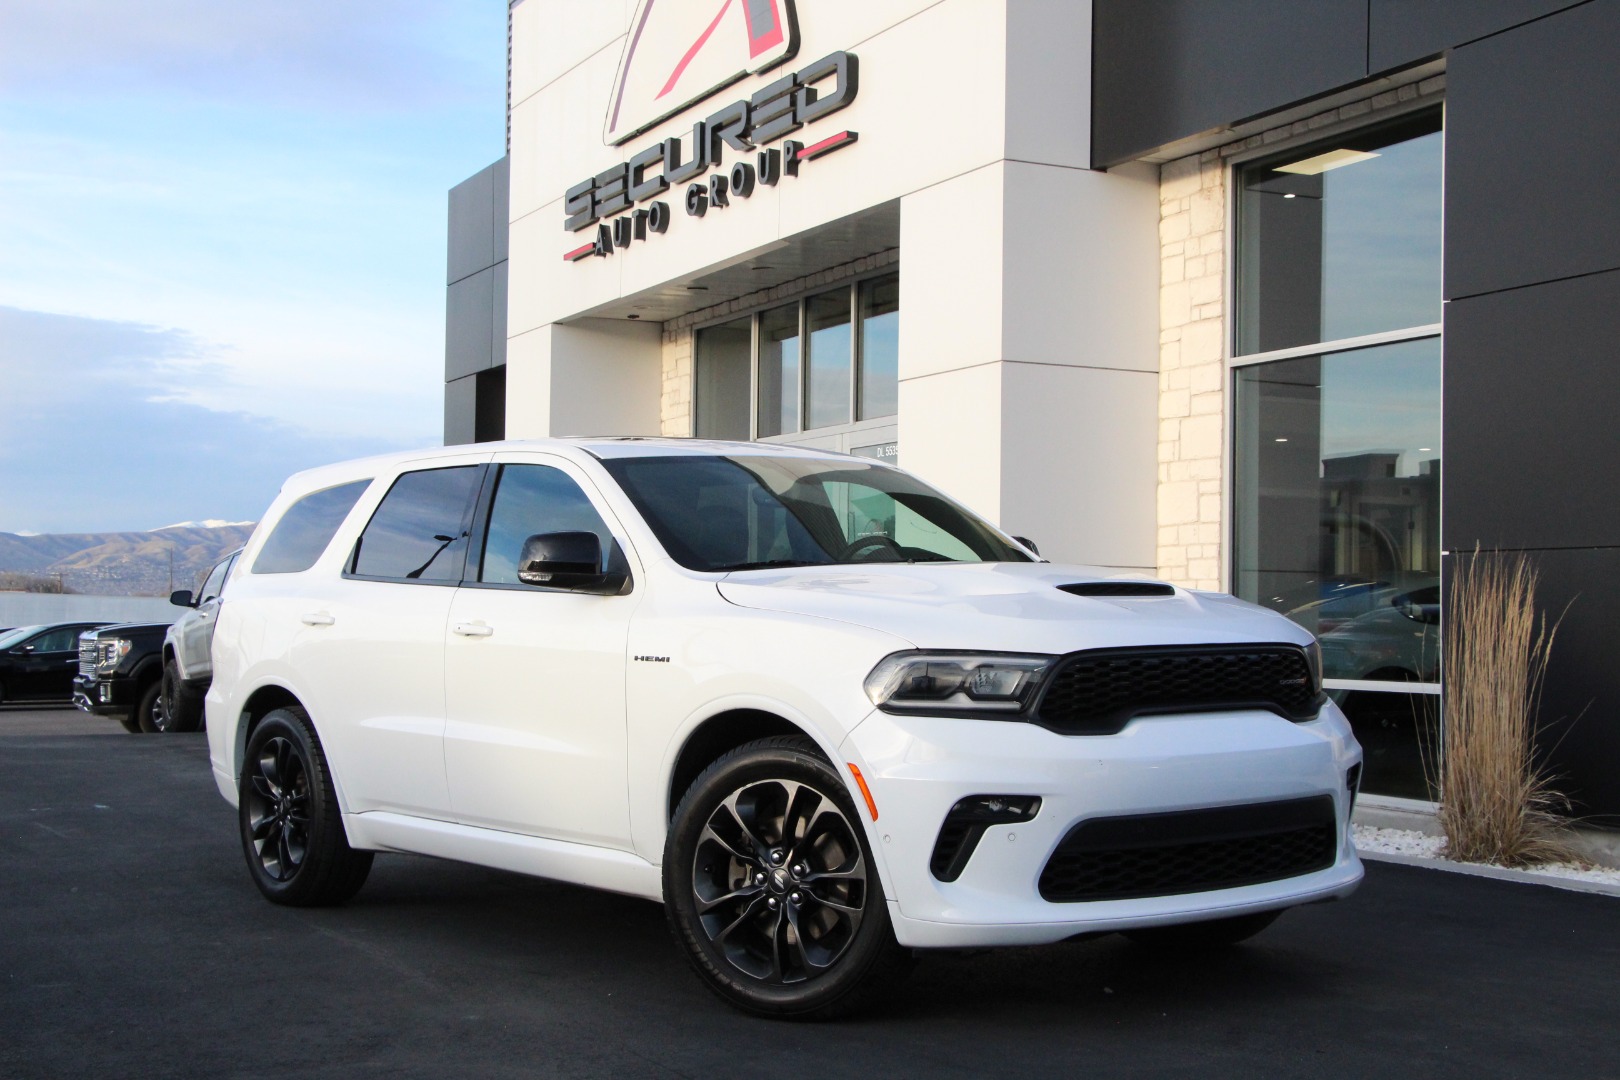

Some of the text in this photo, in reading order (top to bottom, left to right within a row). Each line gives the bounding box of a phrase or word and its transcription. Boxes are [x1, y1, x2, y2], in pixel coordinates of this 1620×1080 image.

[564, 50, 859, 232] SECURED
[594, 139, 805, 258] AUTO GROUP
[634, 655, 671, 663] HEMI
